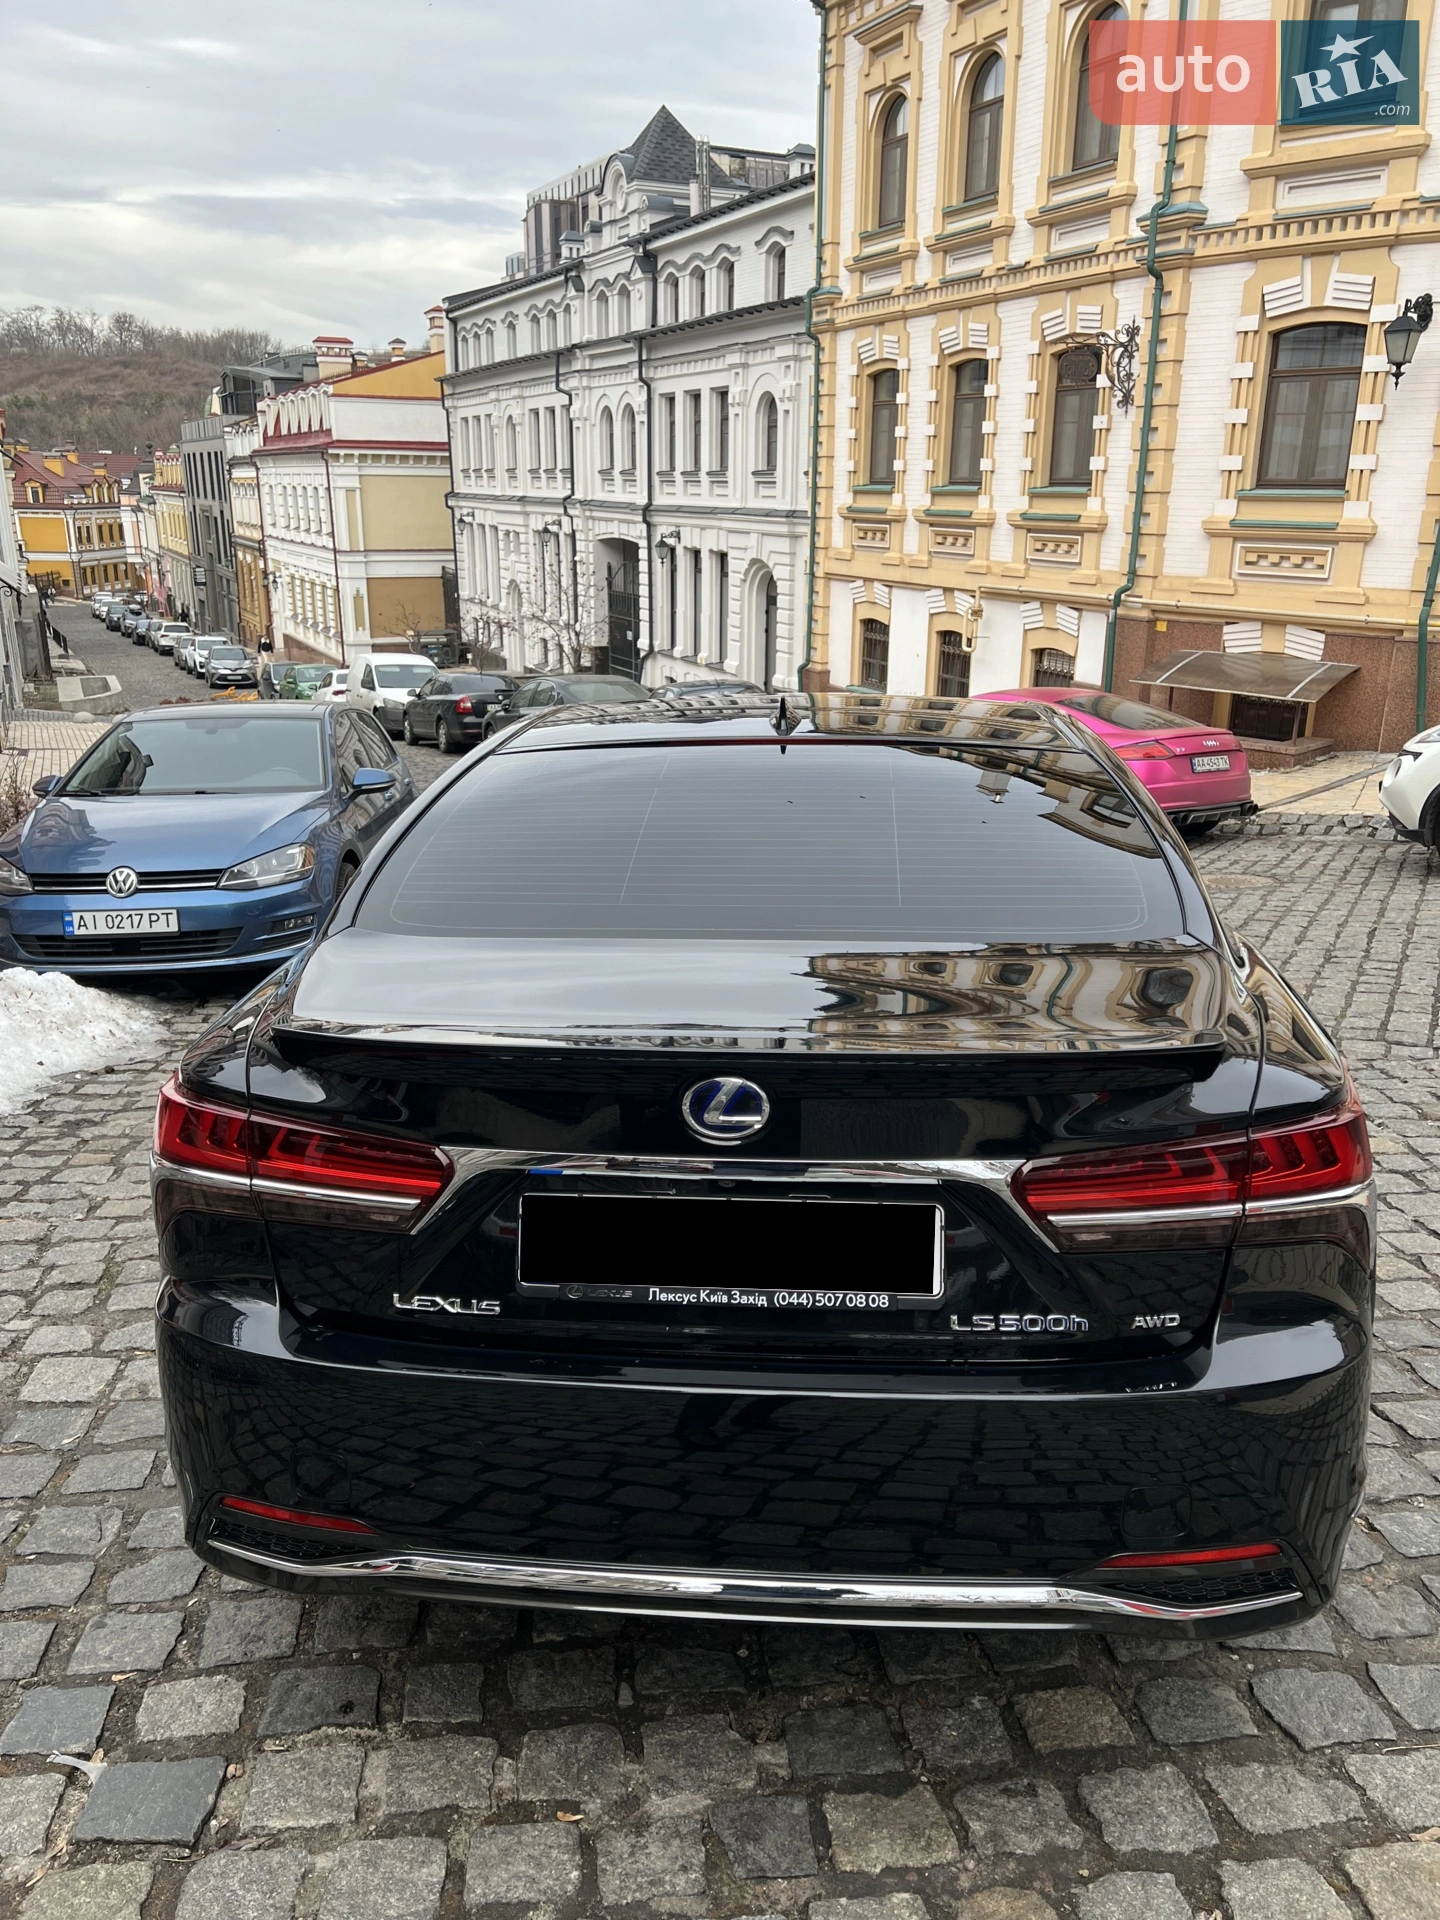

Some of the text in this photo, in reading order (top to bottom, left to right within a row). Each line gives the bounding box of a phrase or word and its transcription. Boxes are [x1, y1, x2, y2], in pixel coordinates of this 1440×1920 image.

[105, 913, 144, 930] 0217
[148, 912, 174, 929] PT
[393, 1293, 501, 1316] LEXUS
[648, 1288, 890, 1308] Лексус Київ Захід (044) 507 08 08
[1131, 1314, 1181, 1330] AWD
